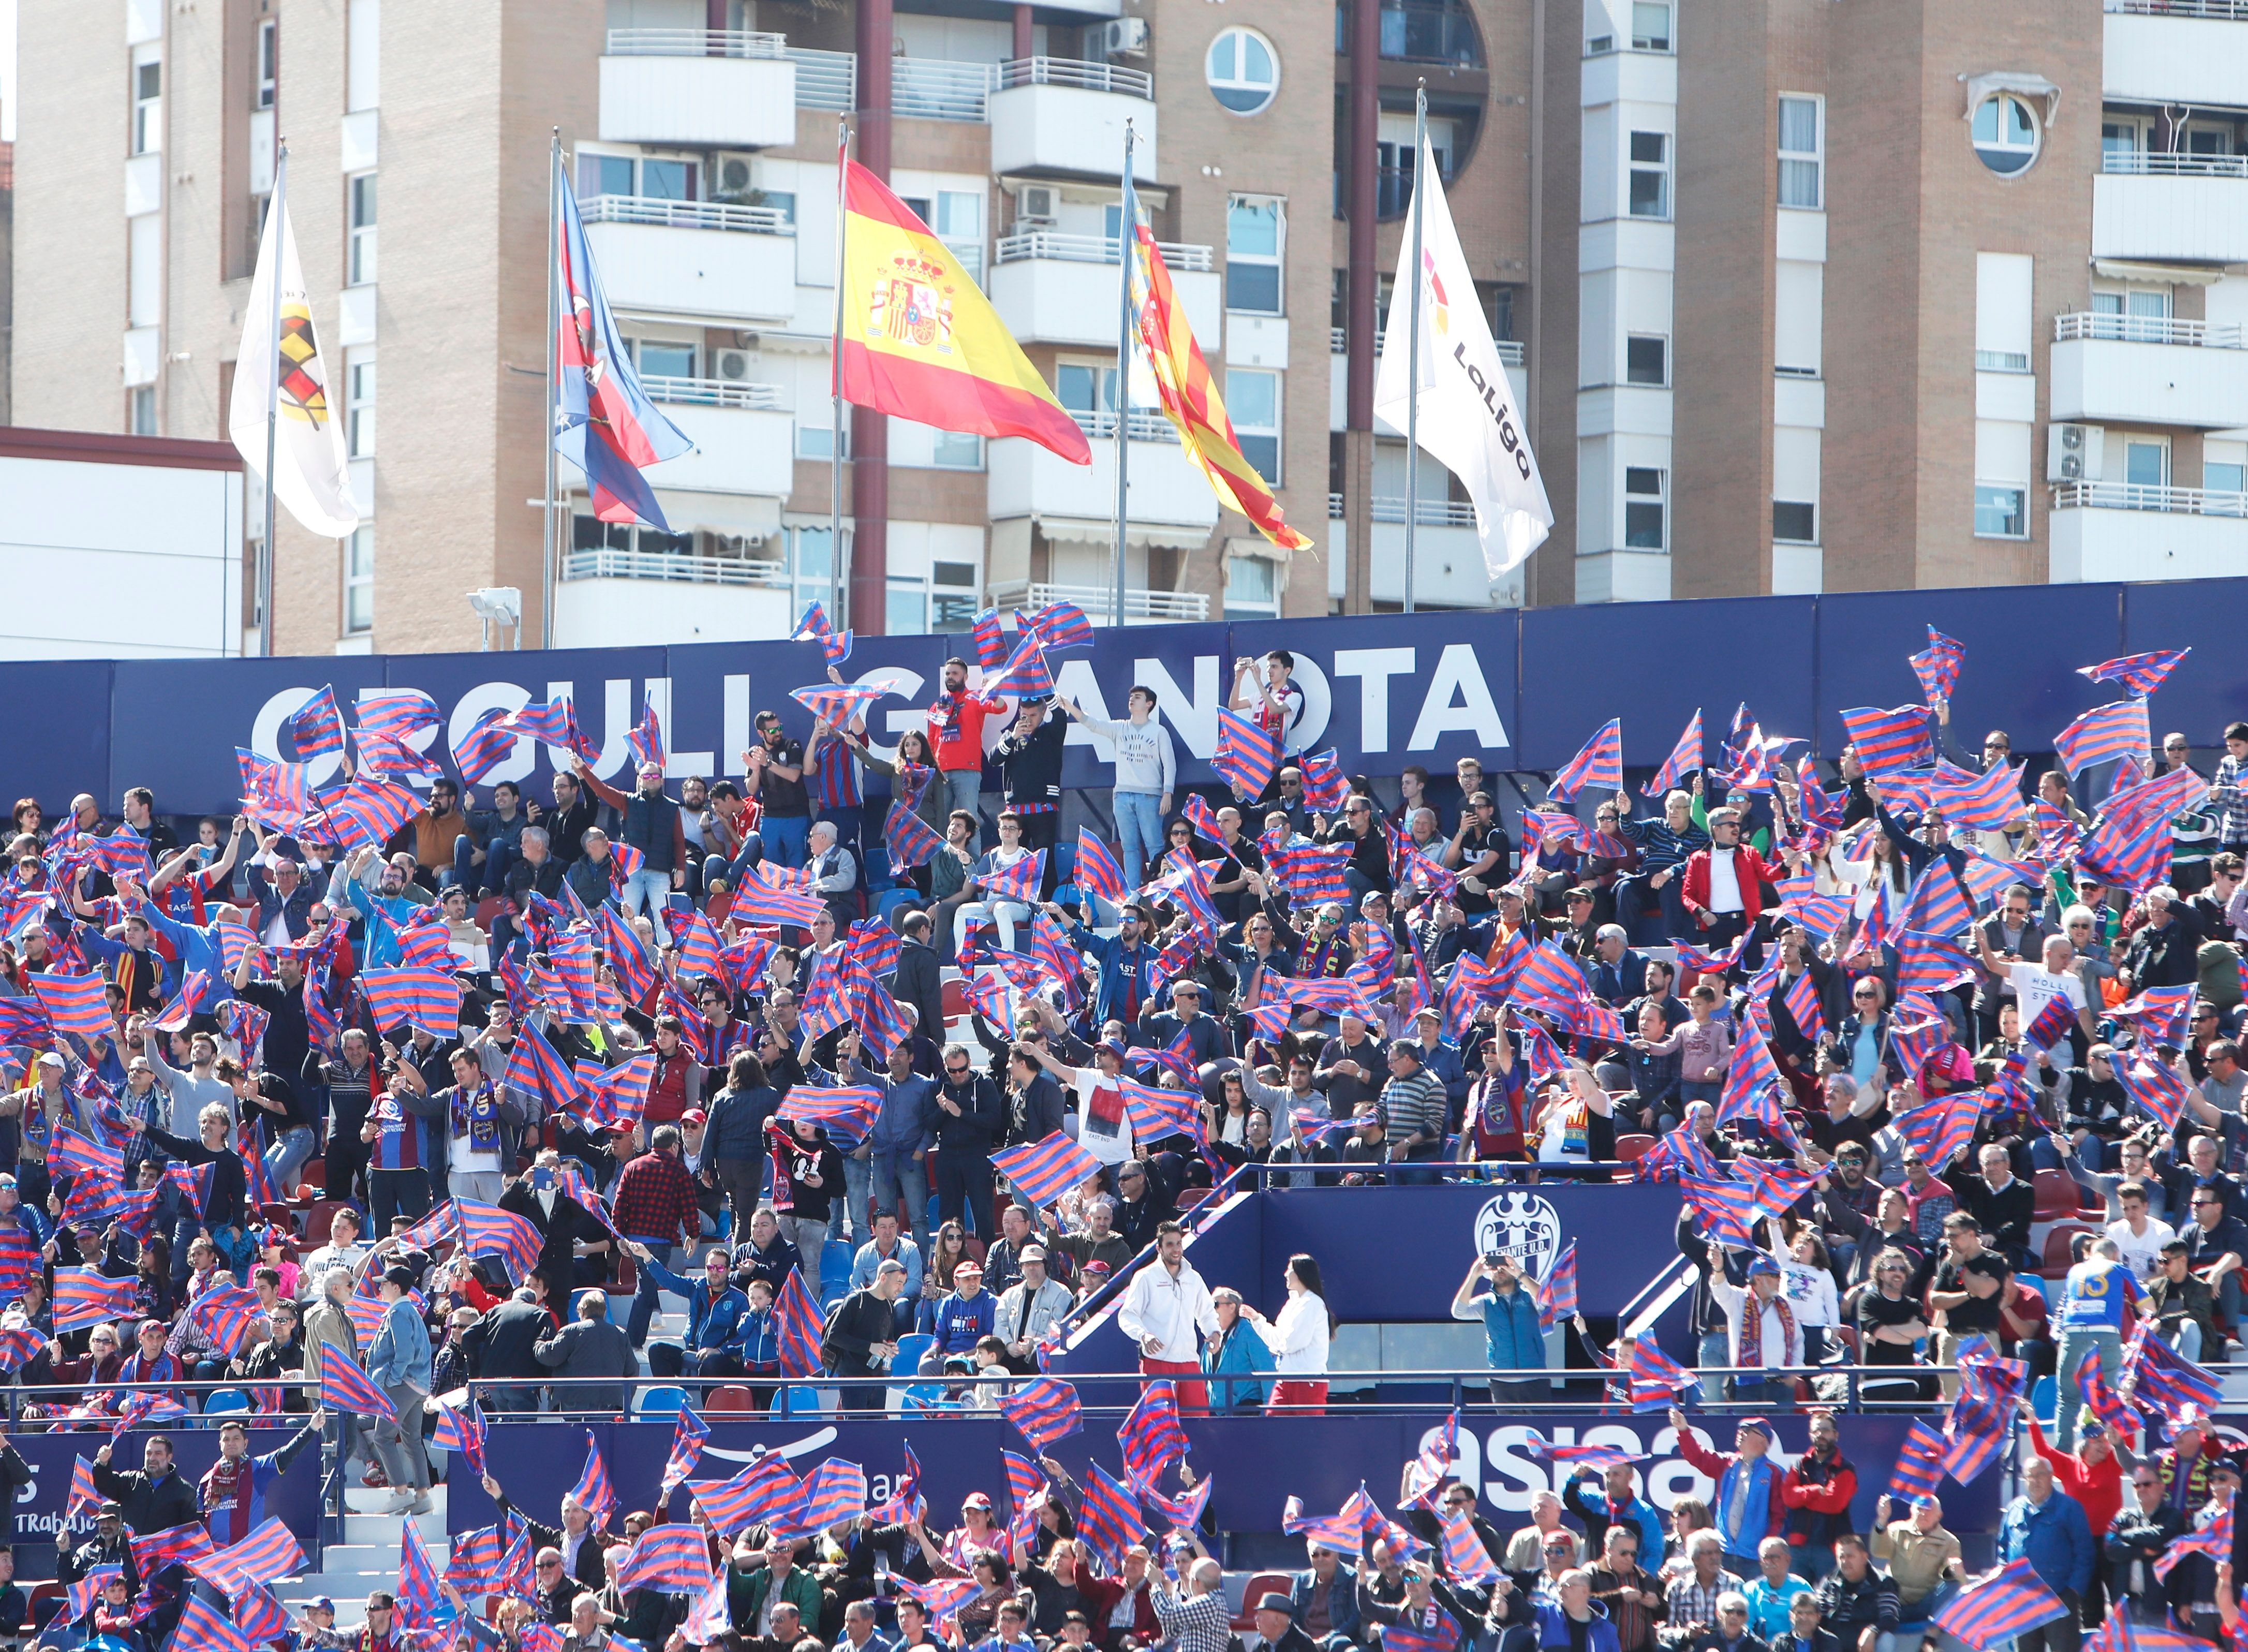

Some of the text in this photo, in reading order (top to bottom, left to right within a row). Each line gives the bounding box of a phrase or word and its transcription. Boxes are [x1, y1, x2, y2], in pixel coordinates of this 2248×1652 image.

[1454, 341, 1530, 481] LaLiga
[855, 643, 1510, 768] GANOTA
[2033, 977, 2069, 991] HOLLI
[2032, 992, 2054, 1001] ST
[1529, 1240, 1547, 1253] U.D.
